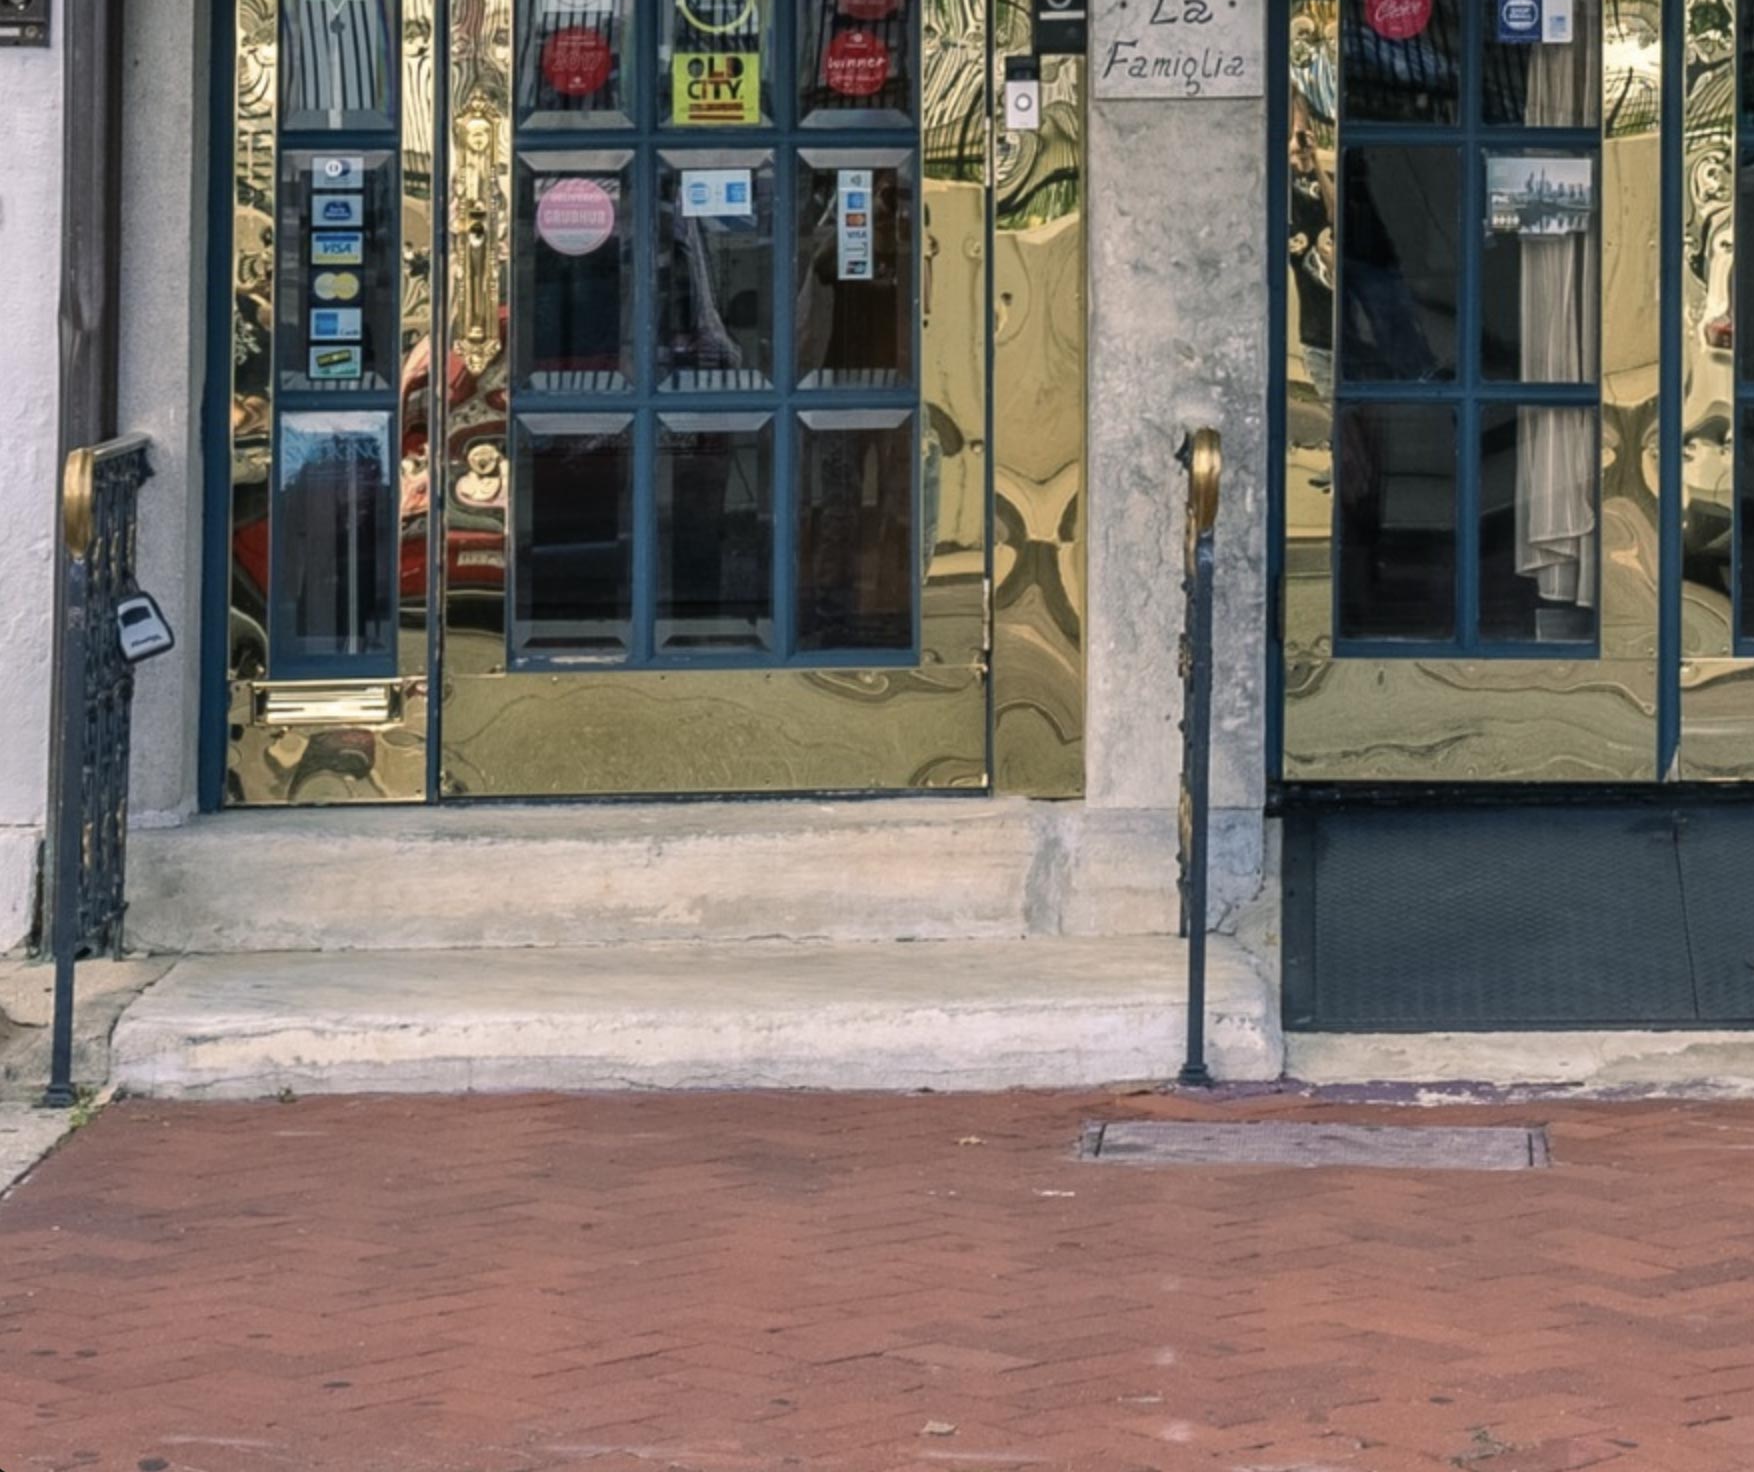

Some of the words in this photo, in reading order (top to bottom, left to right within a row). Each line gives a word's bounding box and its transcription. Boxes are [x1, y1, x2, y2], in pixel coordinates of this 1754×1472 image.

[687, 56, 745, 78] OLD
[1103, 39, 1246, 97] Famiglia
[543, 210, 606, 225] GRUBHUB
[846, 230, 868, 239] VISA
[322, 242, 353, 254] VISA
